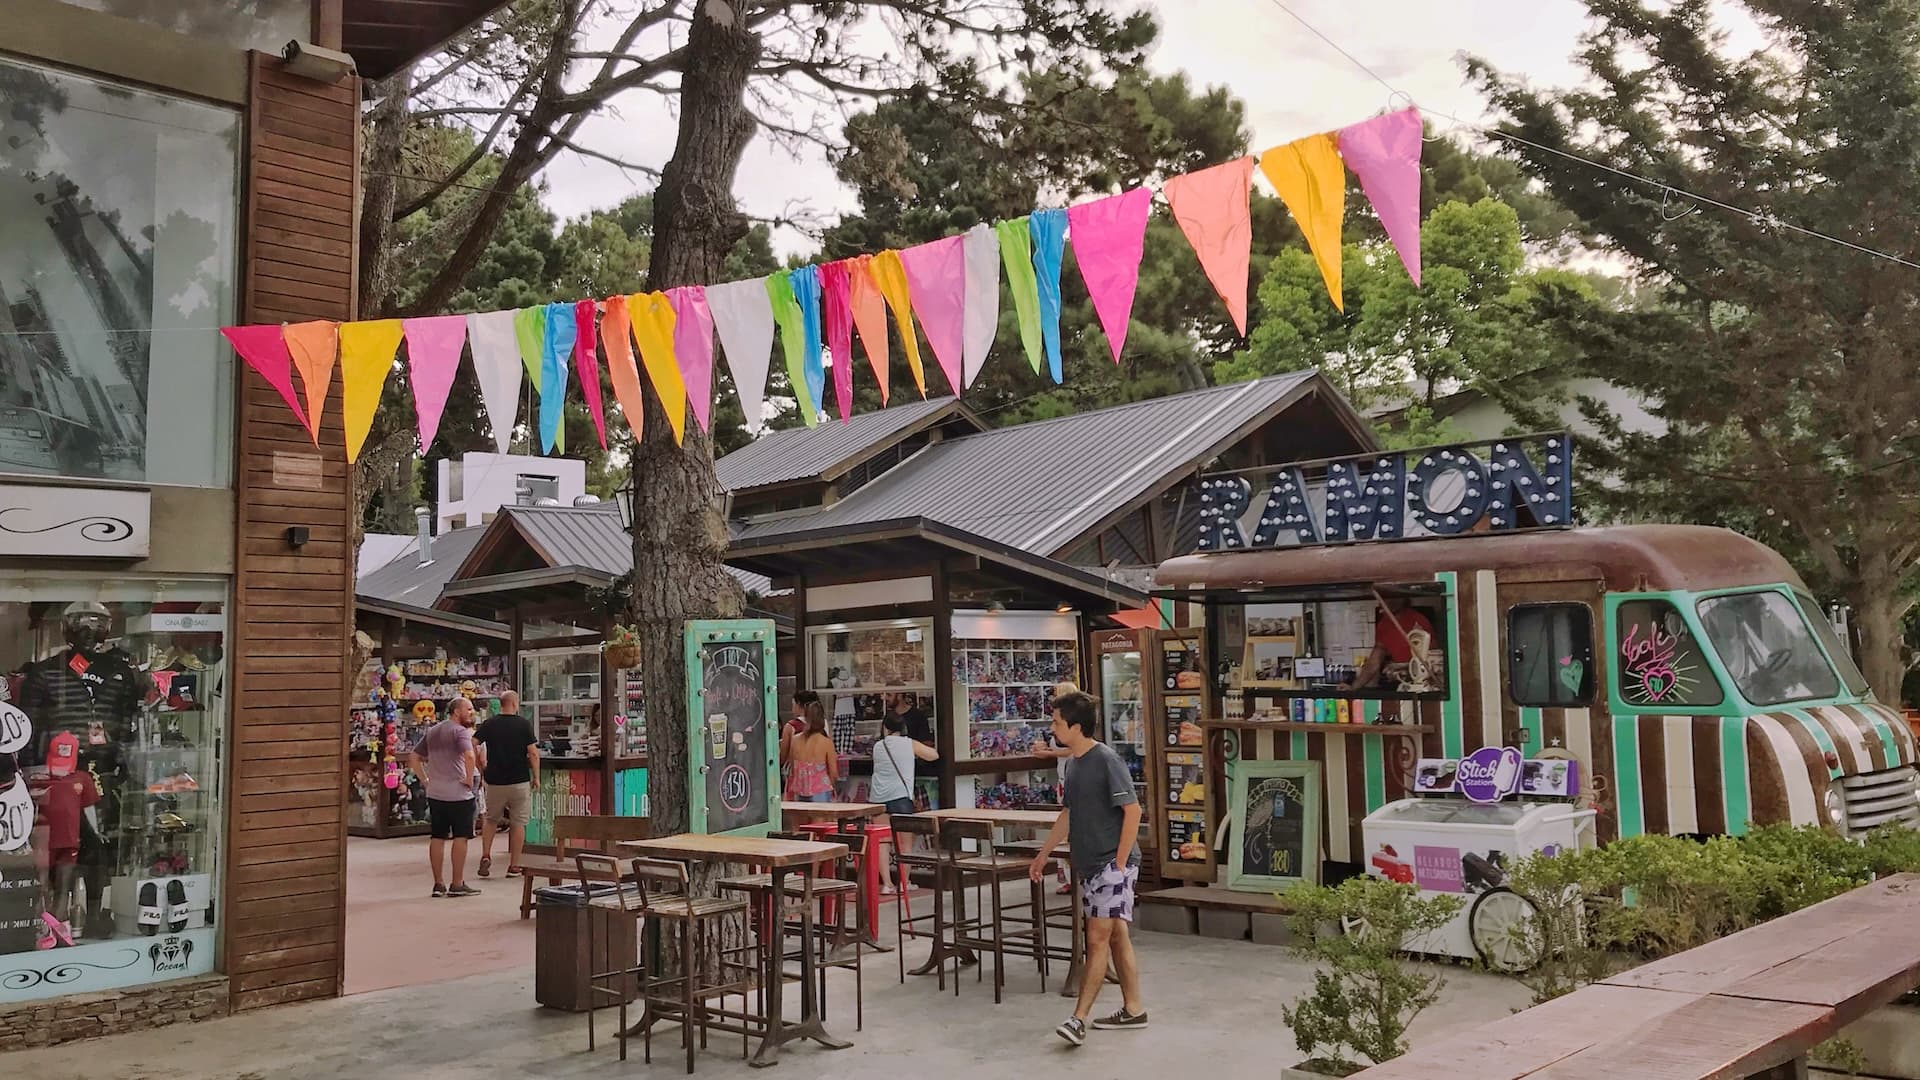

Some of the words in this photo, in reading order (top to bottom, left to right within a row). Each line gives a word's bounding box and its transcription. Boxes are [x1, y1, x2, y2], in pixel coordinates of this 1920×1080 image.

[1198, 434, 1571, 549] RAMON
[1101, 640, 1133, 650] PATAGONIA
[1459, 759, 1497, 781] Stick
[1465, 779, 1495, 787] Station
[631, 793, 651, 817] LA
[143, 911, 160, 919] FILA
[174, 908, 189, 917] FILA
[156, 962, 185, 972] Ocean
